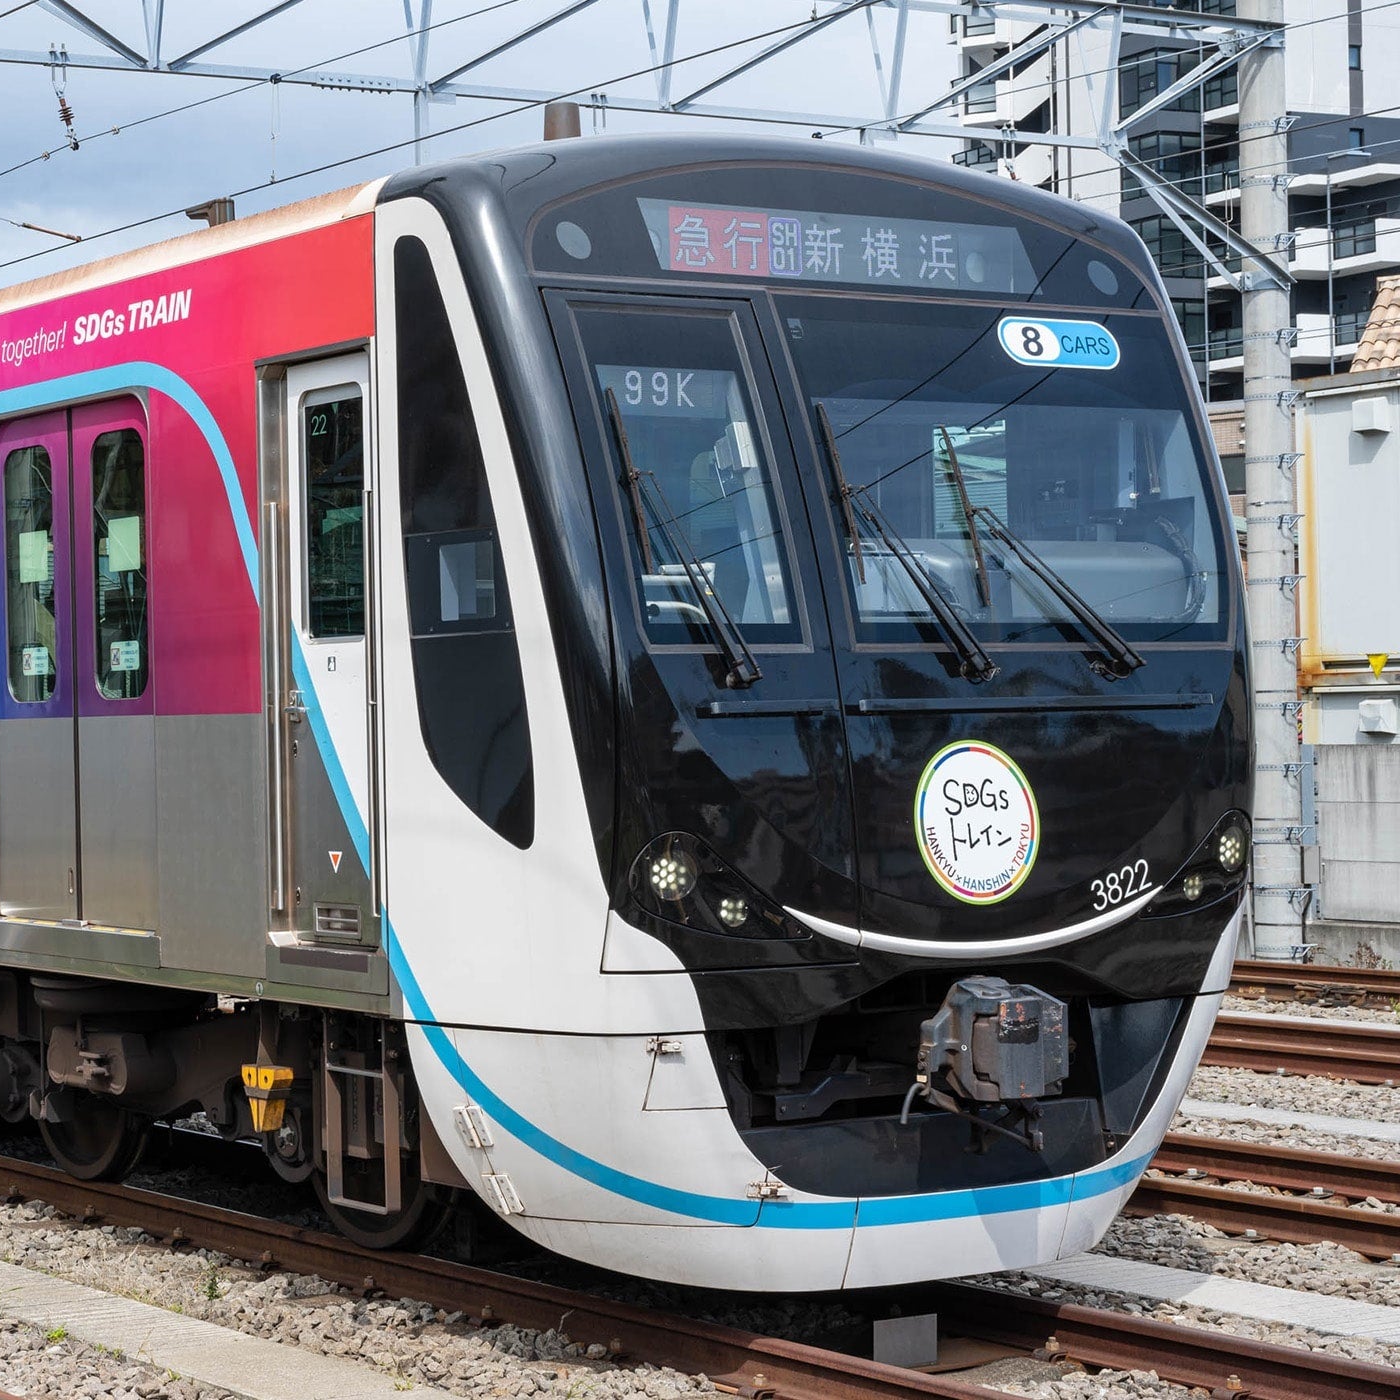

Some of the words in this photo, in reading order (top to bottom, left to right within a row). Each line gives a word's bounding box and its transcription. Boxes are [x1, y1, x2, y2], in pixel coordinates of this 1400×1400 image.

[673, 214, 764, 271] 急行
[771, 222, 798, 248] SH
[804, 223, 957, 281] 新横浜
[772, 248, 796, 272] 01
[1, 320, 67, 367] together!
[72, 309, 125, 346] SDGs
[127, 289, 192, 332] TRAIN
[1021, 326, 1044, 356] 8
[1060, 335, 1110, 355] CARS
[624, 370, 695, 407] 99K
[311, 414, 327, 436] 22
[942, 778, 1010, 816] SDGs
[926, 826, 957, 878] HANKYU
[962, 869, 1011, 891] HANSHIN
[1011, 822, 1030, 867] TOKYU
[949, 817, 1012, 862] トレイン
[1090, 858, 1153, 912] 3822
